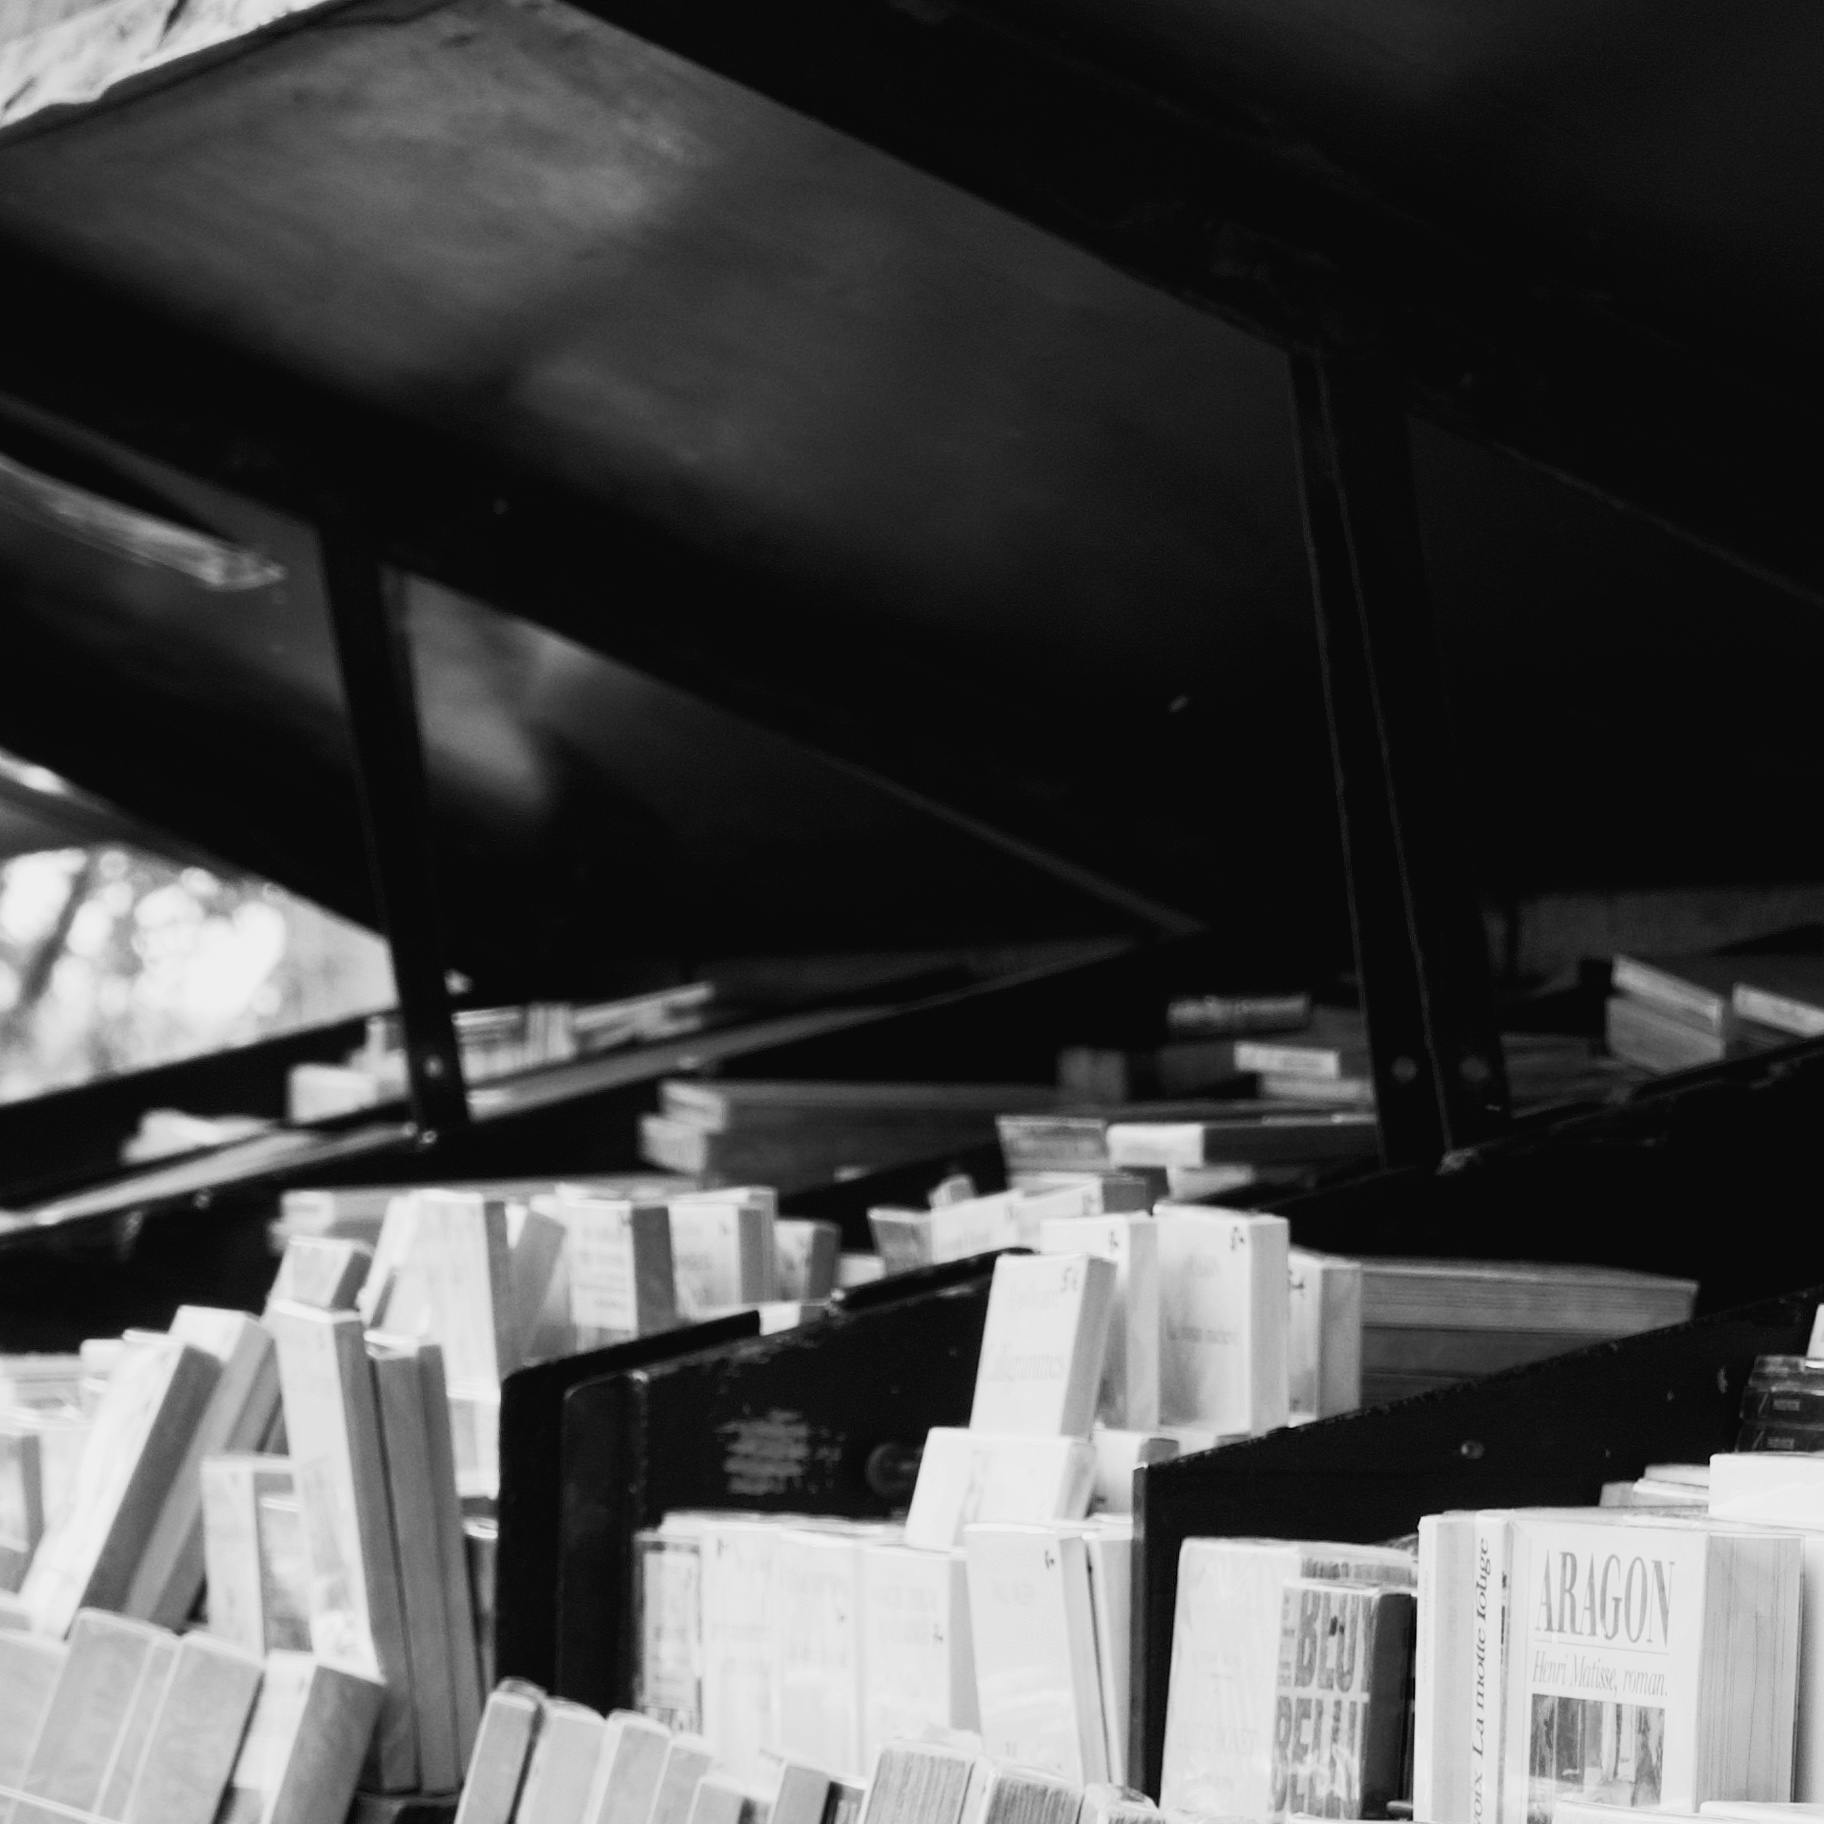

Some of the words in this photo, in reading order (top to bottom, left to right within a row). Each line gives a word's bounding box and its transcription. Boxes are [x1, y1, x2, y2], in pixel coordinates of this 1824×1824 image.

[1533, 1548, 1676, 1649] ARAGON
[1531, 1649, 1567, 1684] Henri
[1567, 1654, 1618, 1697] Matisse,
[1621, 1667, 1669, 1698] roman.
